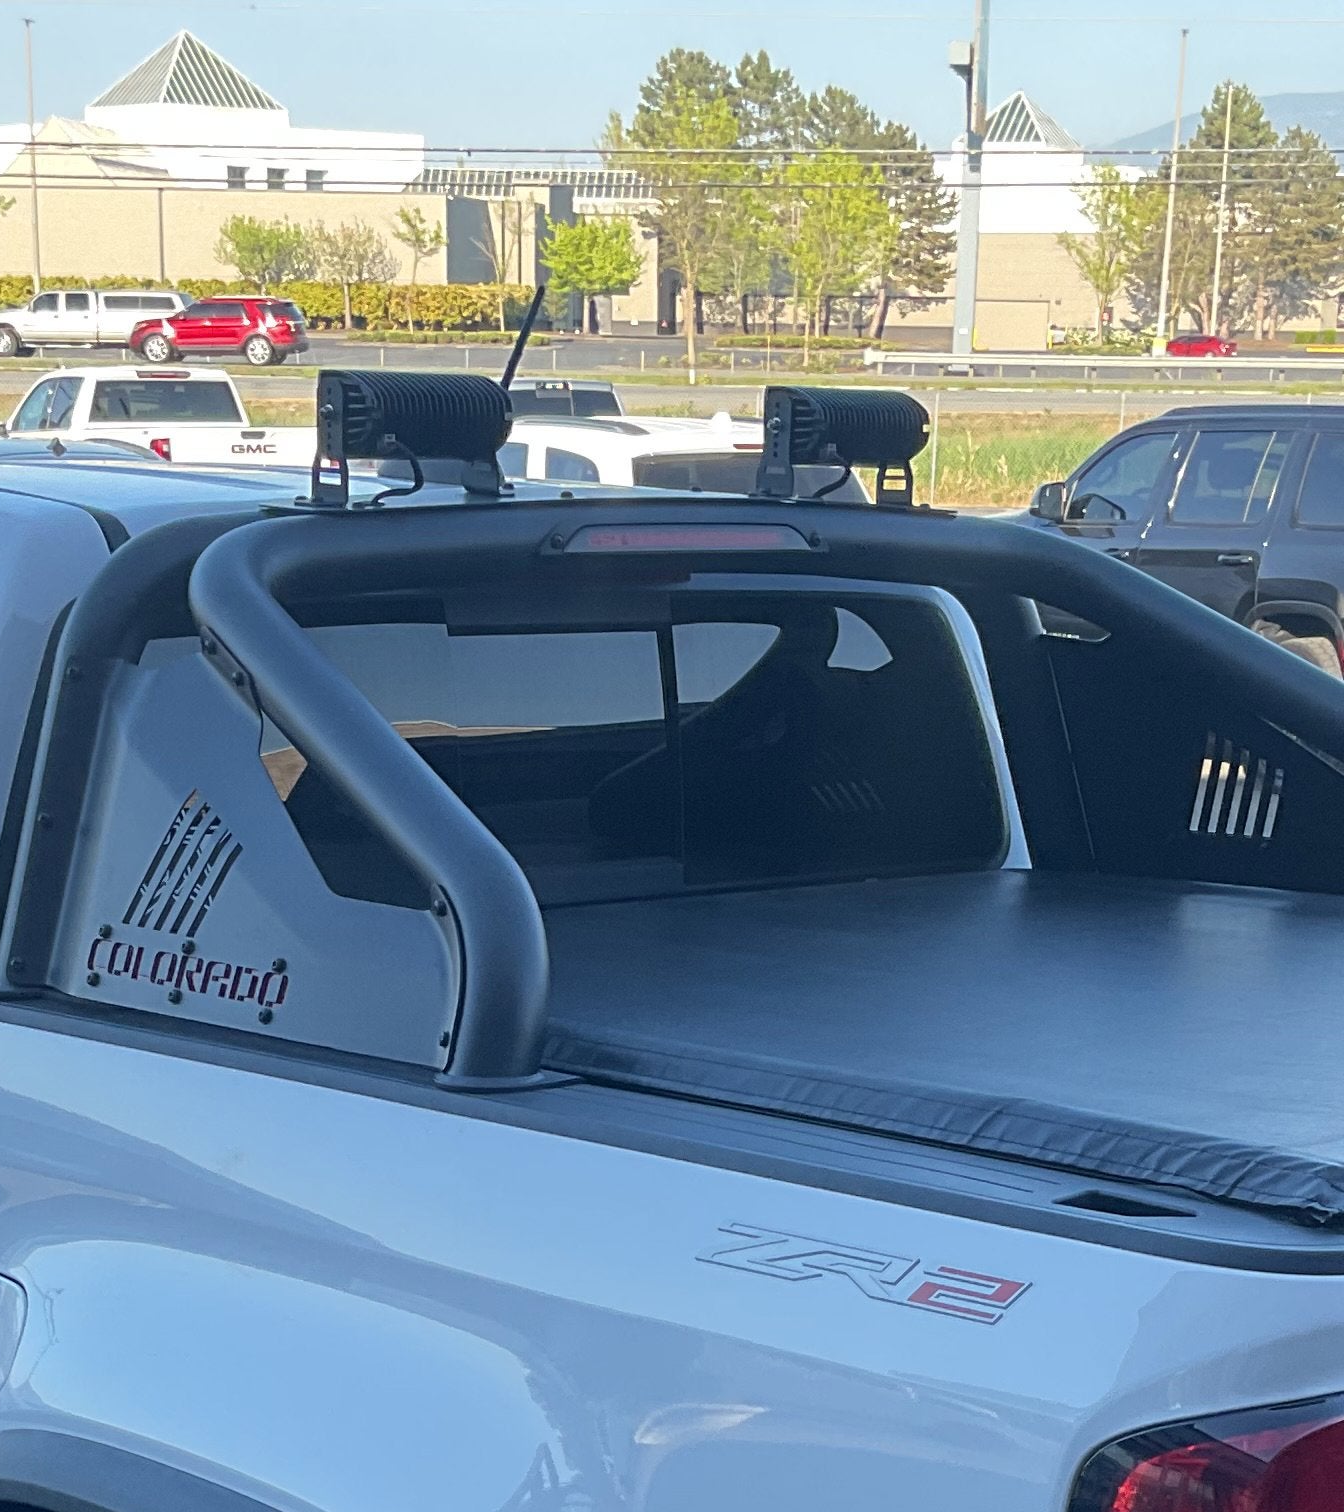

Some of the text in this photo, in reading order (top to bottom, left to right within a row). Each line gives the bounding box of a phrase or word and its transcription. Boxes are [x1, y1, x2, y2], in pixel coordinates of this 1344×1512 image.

[231, 444, 278, 454] GMC
[86, 937, 290, 1008] COLORADO
[694, 1221, 1034, 1326] ZR2
